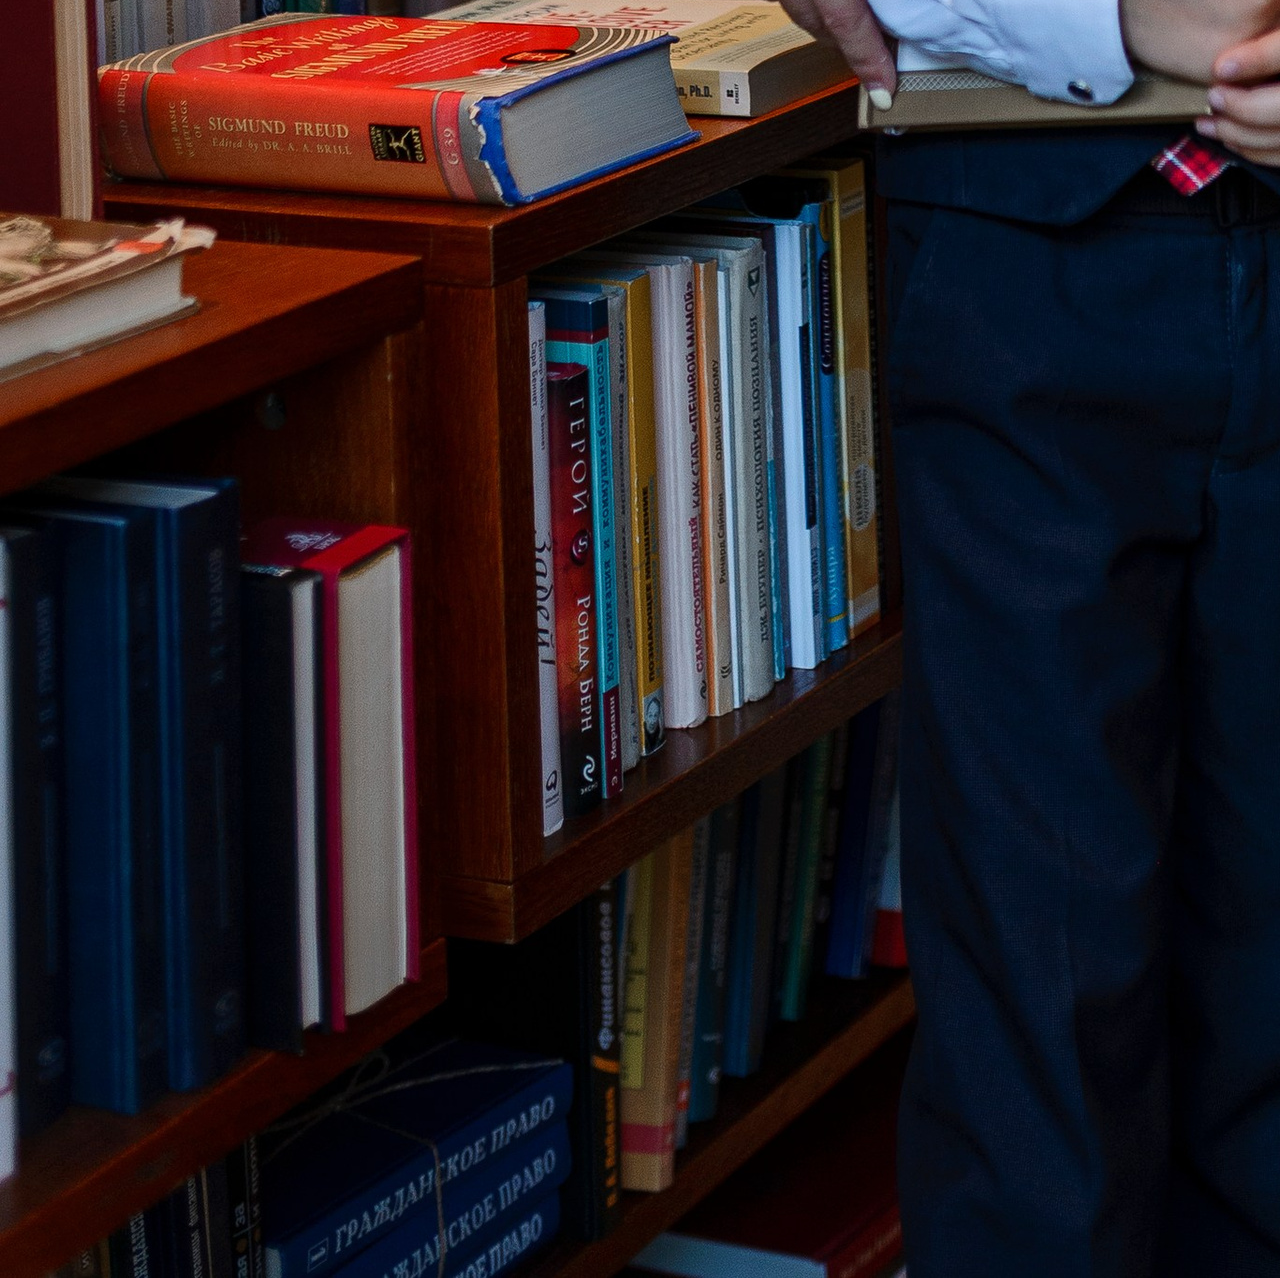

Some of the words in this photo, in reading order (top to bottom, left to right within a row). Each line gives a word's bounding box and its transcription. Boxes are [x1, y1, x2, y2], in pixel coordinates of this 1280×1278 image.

[117, 74, 130, 113] FREUD
[690, 85, 712, 98] Ph.D.
[169, 102, 178, 133] BASIC
[180, 100, 195, 157] WRITINGS
[193, 124, 202, 139] OF
[208, 116, 286, 135] SIGMUND
[294, 122, 349, 139] FREUD
[443, 127, 456, 148] 39
[212, 137, 242, 149] Edited
[247, 140, 259, 153] by
[262, 141, 284, 152] DR.
[287, 143, 299, 152] A.
[301, 144, 312, 153] A.
[316, 144, 352, 155] BRILL
[411, 128, 424, 162] GIANT
[818, 258, 832, 369] Соционика
[531, 341, 539, 366] Сара
[747, 314, 761, 412] ПОЗНАНИЯ
[531, 369, 540, 407] Беннет
[710, 358, 722, 419] ОДНОМУ
[568, 395, 591, 514] ГЕРОЙ
[595, 345, 608, 529] коммуникабельность
[714, 432, 723, 461] ОДИН
[751, 416, 766, 532] ПСИХОЛОГИЯ
[641, 487, 653, 580] МЫШЛЕНИЕ
[715, 492, 727, 545] Саймон
[601, 539, 610, 548] и
[717, 548, 728, 583] Ричард
[601, 560, 616, 683] Коммуникация
[335, 1137, 487, 1254] ГРАЖДАНСКОЕ
[490, 1095, 555, 1154] ПРАВО
[499, 1149, 557, 1211] ПРАВО
[489, 1212, 544, 1278] ПРАВО
